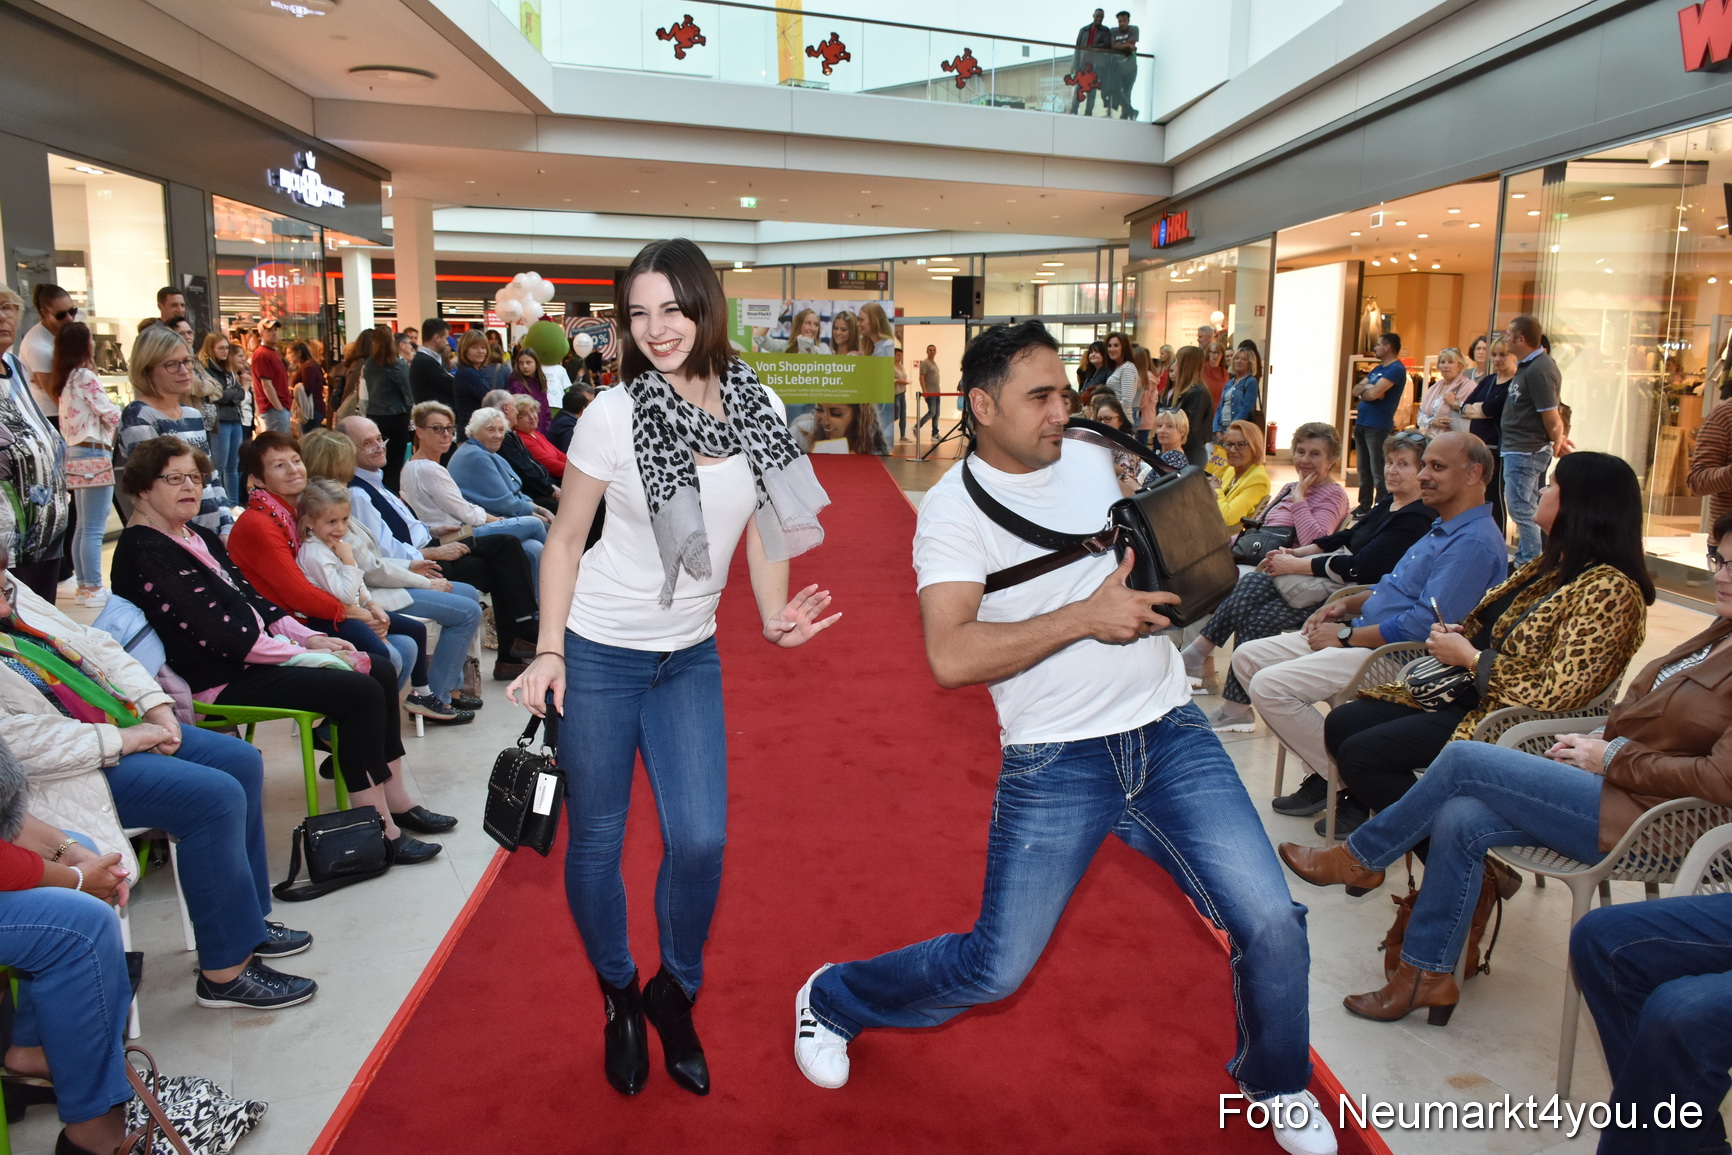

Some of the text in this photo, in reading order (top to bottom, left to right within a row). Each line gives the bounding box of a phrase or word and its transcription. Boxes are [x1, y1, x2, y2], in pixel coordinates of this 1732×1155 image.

[755, 361, 856, 374] Von Shoppingtour
[767, 374, 844, 387] bis Leben pur.
